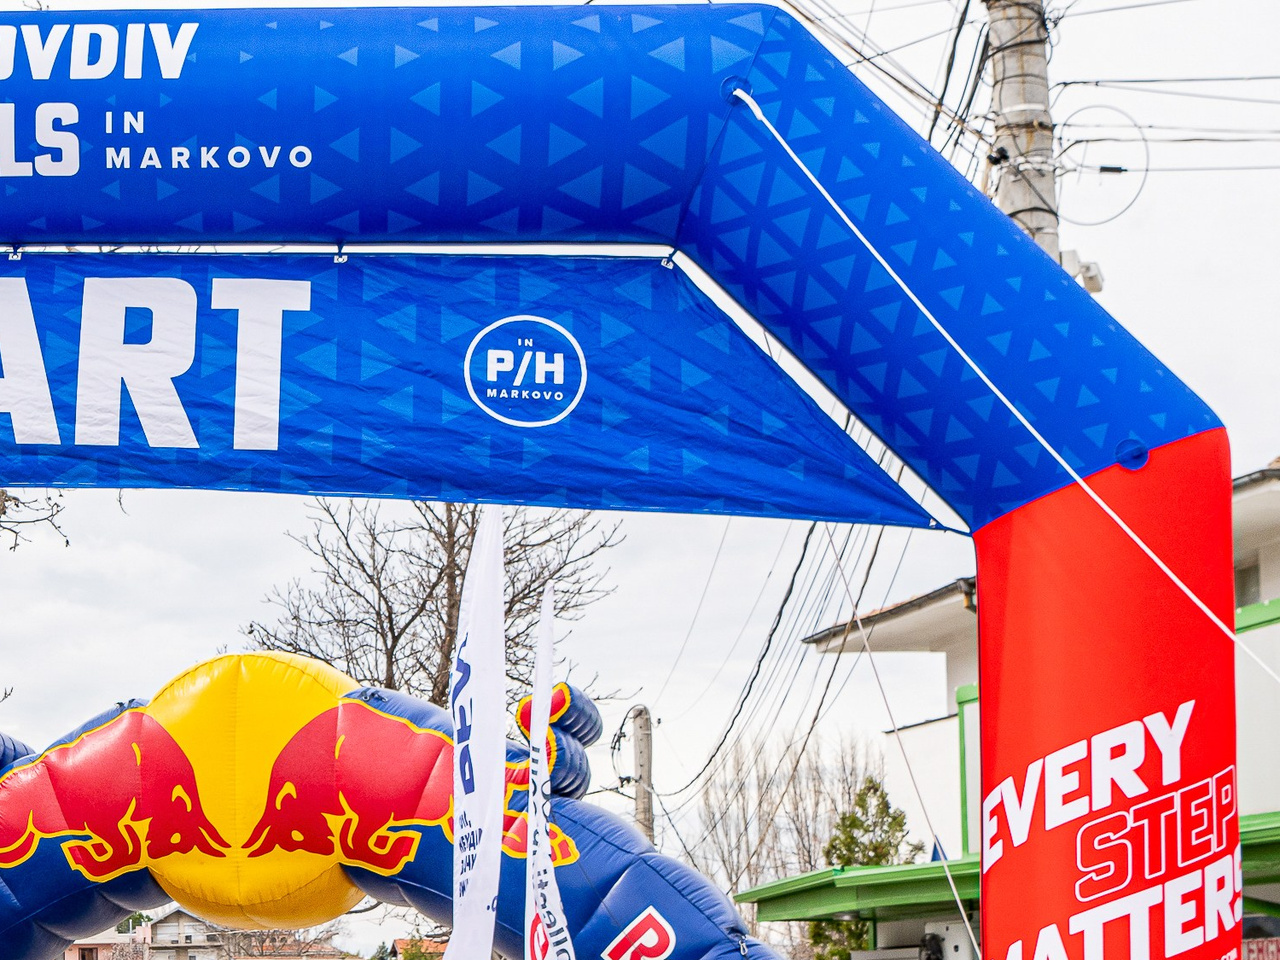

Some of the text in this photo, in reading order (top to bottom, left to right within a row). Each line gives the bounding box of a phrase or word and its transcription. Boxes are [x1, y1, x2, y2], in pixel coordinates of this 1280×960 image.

[105, 111, 145, 134] IN
[105, 145, 313, 169] MARKOVO
[517, 338, 533, 347] IN
[486, 349, 564, 387] P/H
[486, 388, 564, 401] MARKOVO
[983, 700, 1196, 875] EVERY
[1075, 765, 1237, 903] STEP
